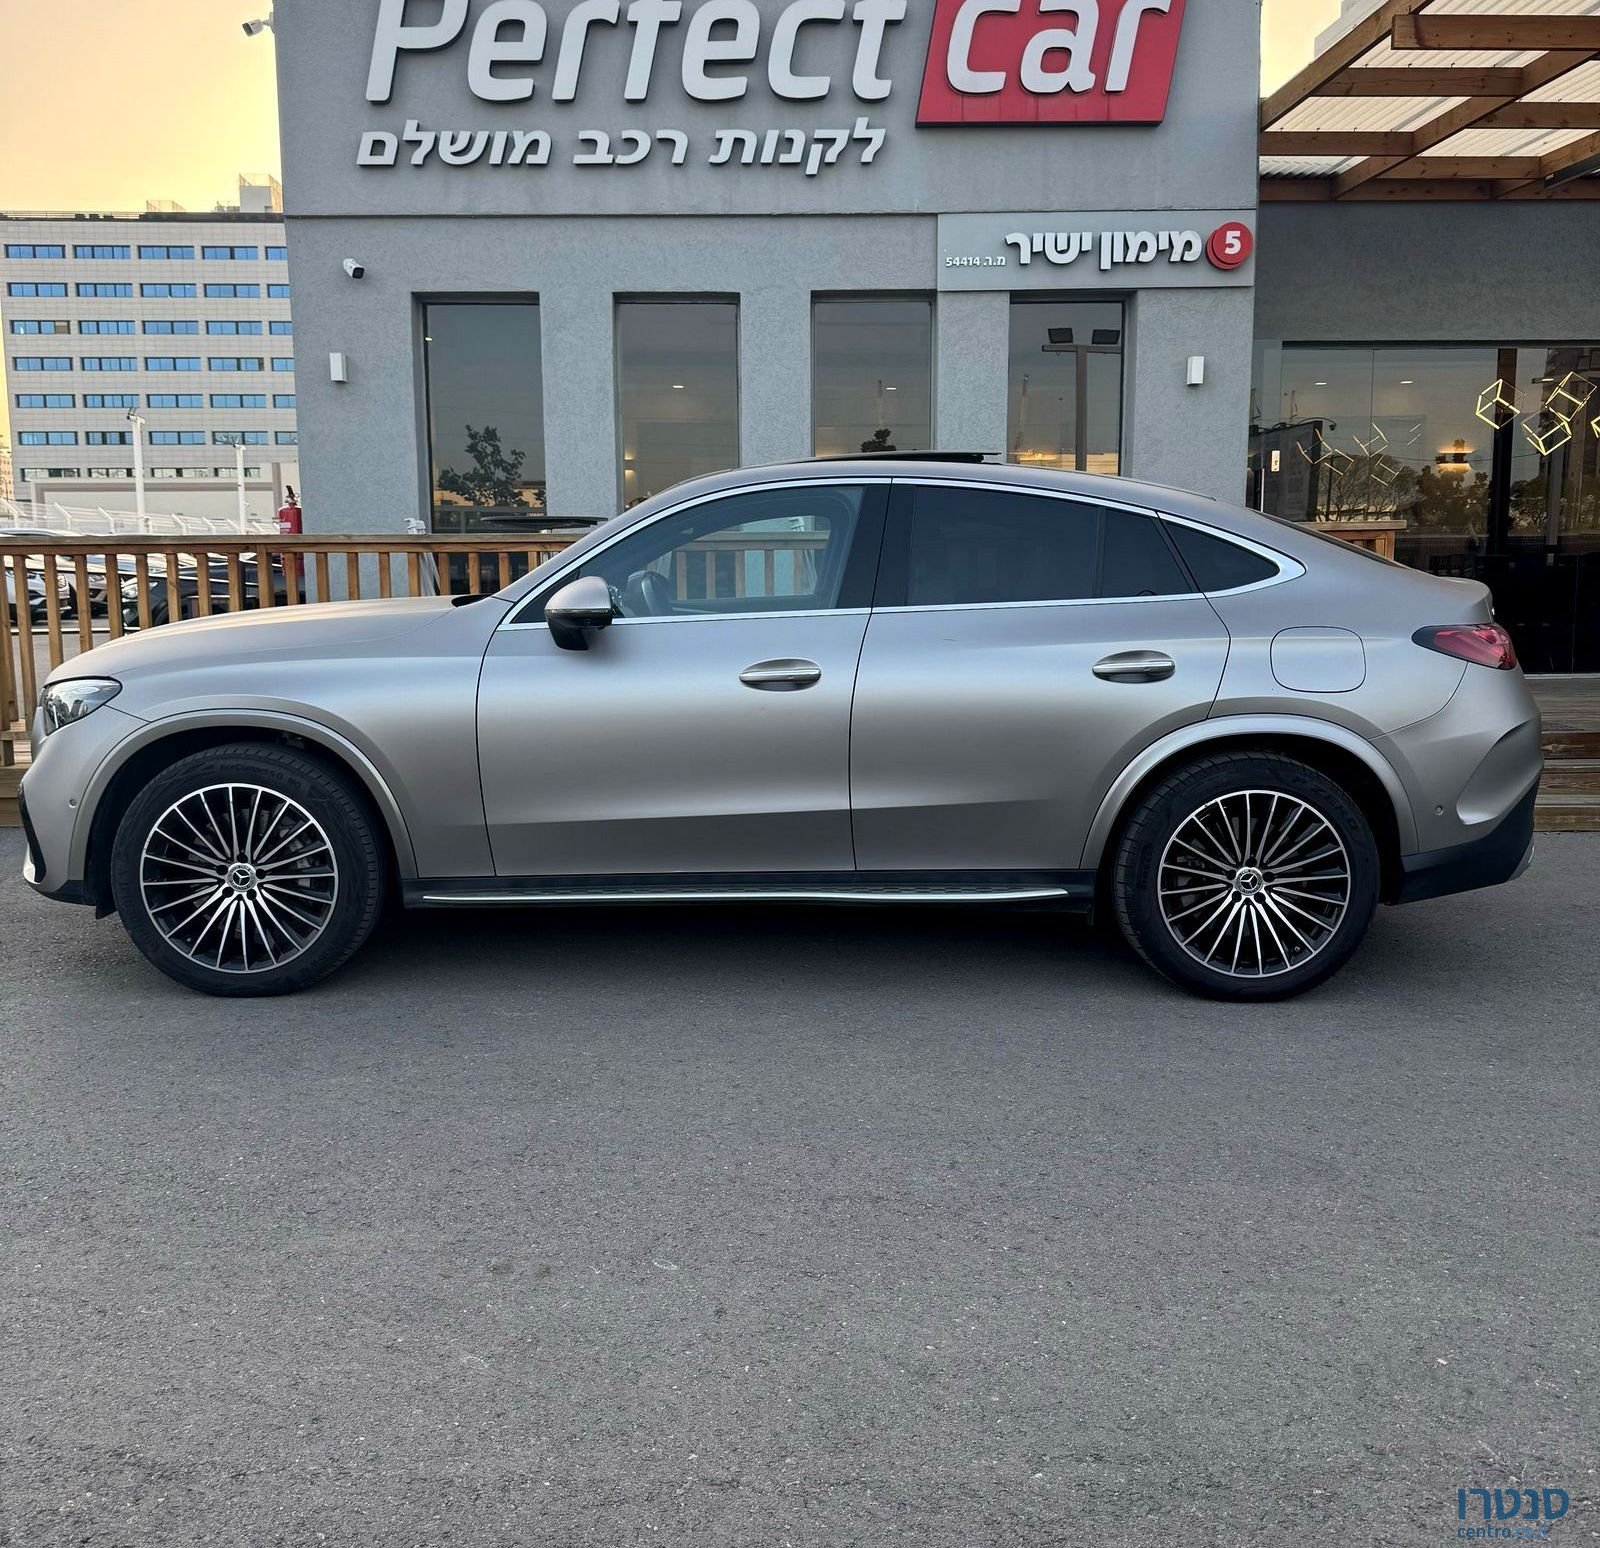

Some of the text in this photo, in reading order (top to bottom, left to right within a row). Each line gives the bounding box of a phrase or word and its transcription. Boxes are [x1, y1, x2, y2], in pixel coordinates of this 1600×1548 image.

[365, 0, 906, 101] Perfect
[356, 117, 886, 176] לקנות רכב מושלם
[945, 256, 981, 267] 54414
[1005, 230, 1242, 271] 5 מימון ישיר
